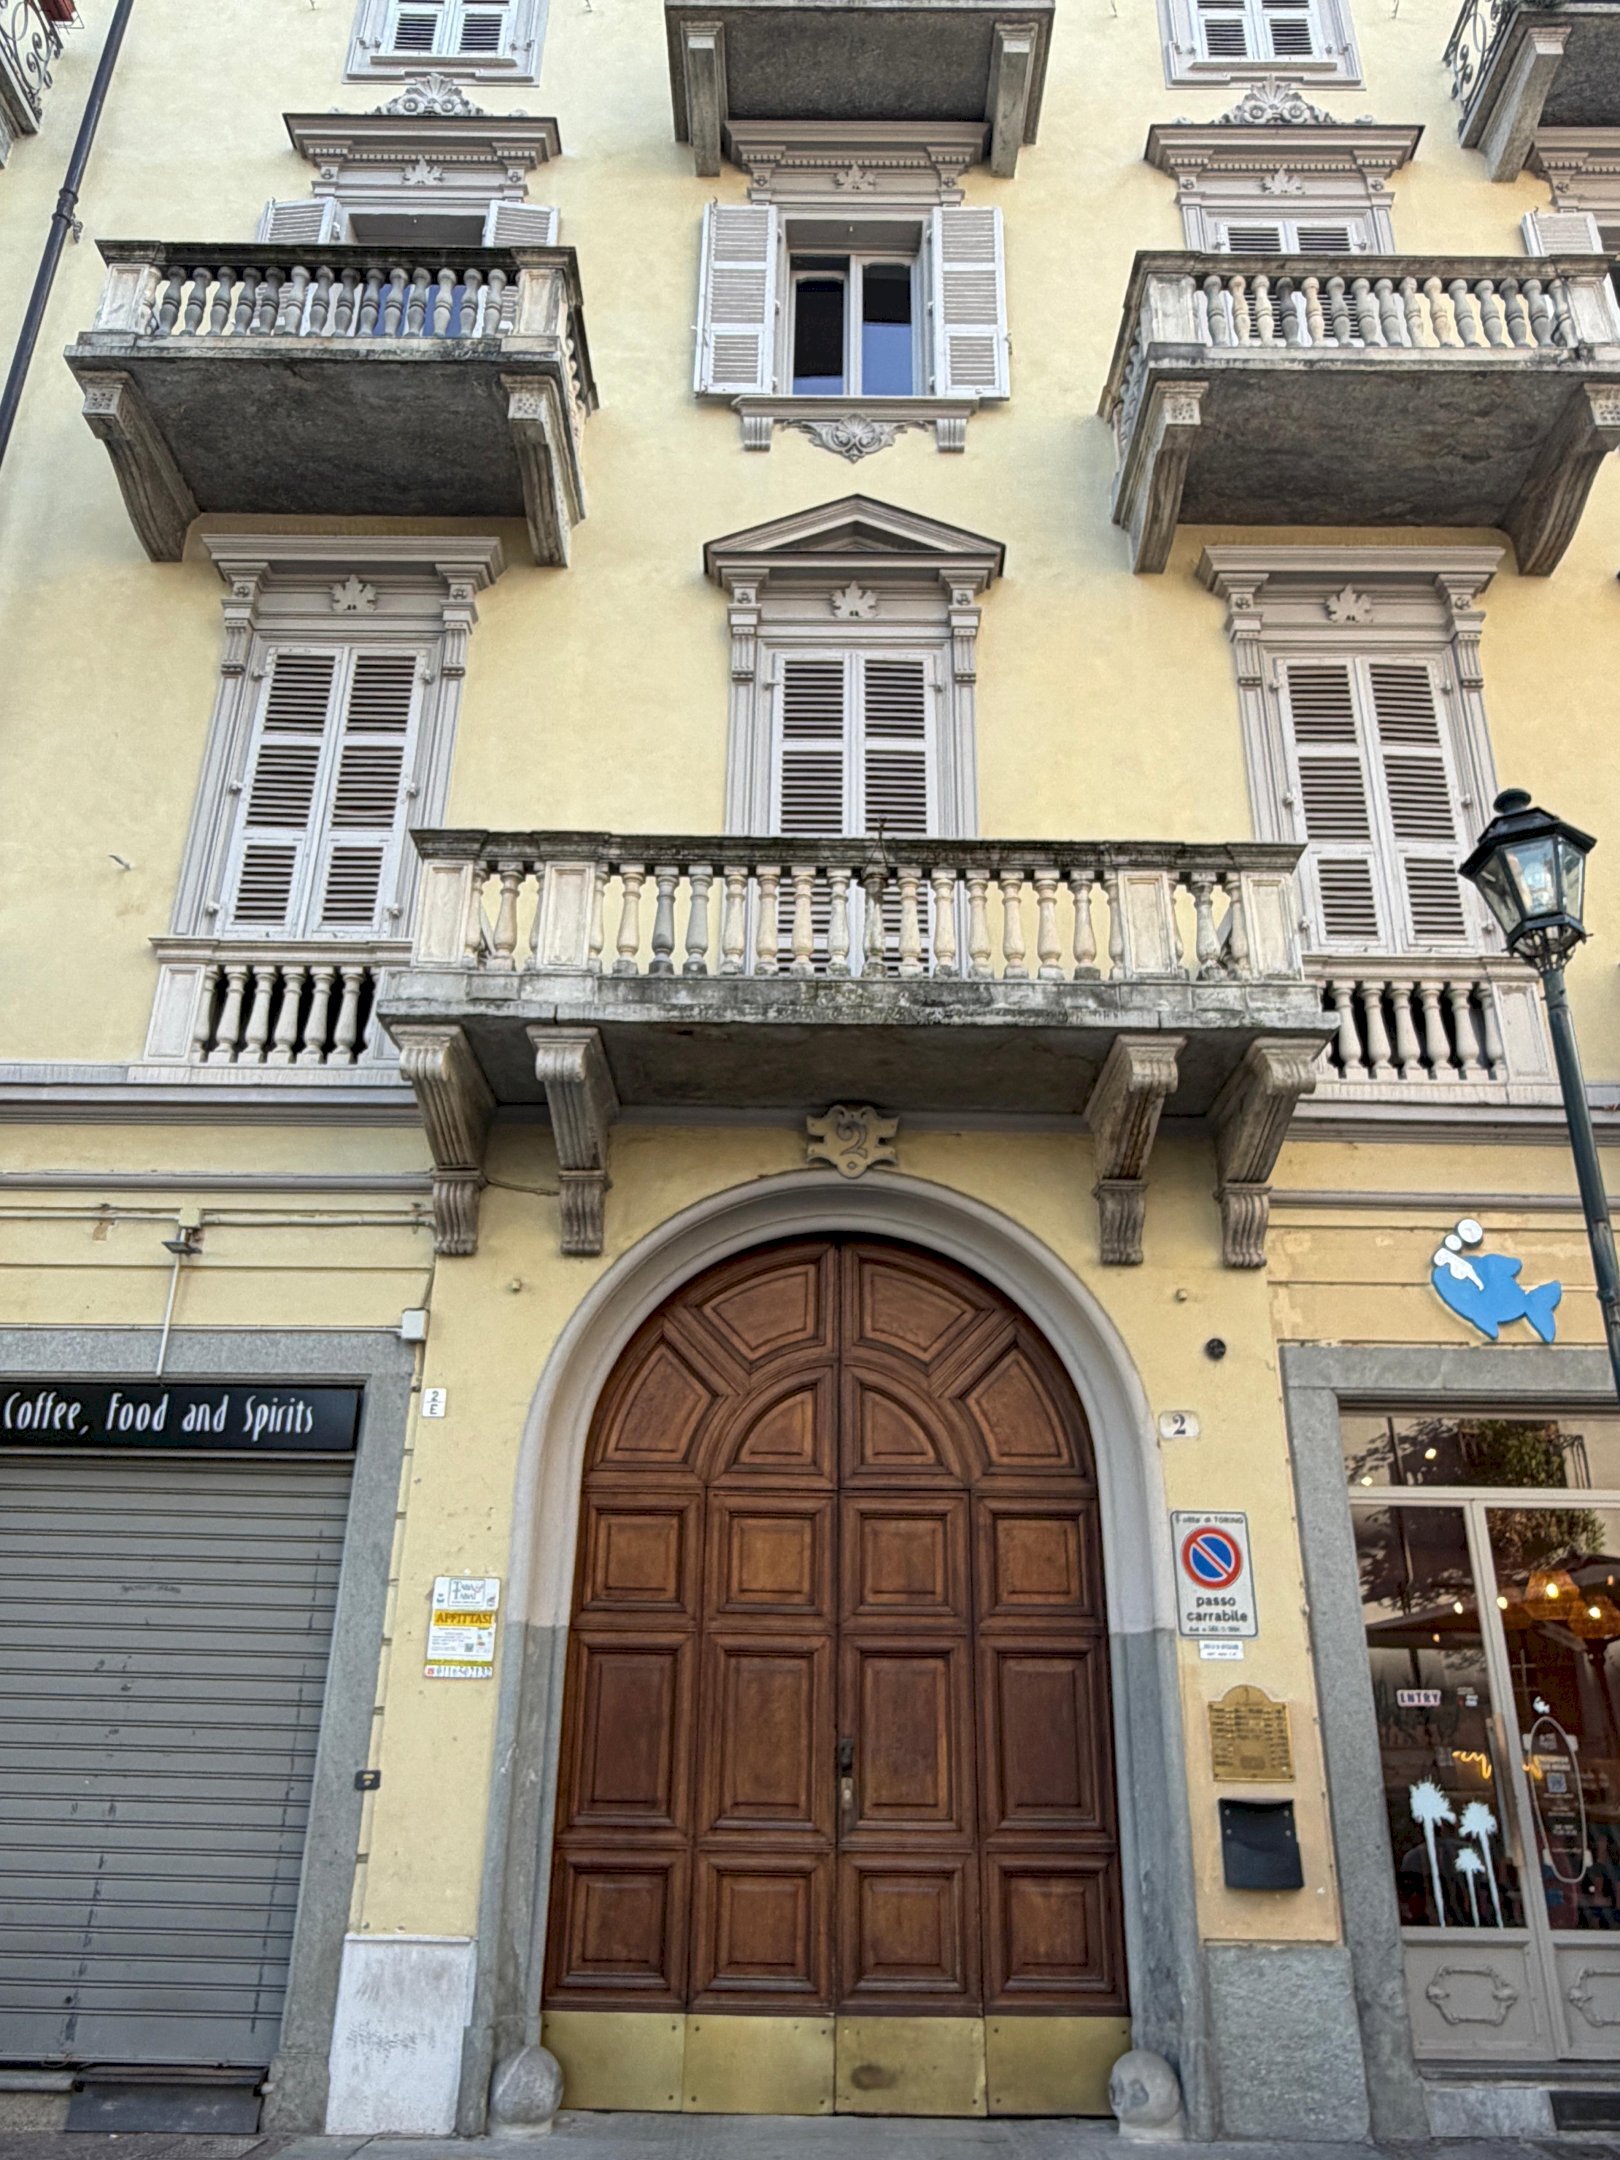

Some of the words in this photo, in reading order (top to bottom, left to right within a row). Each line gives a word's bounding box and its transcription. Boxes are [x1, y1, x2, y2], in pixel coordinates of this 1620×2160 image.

[837, 1121, 868, 1159] 2
[431, 1390, 440, 1402] 2
[430, 1403, 438, 1415] E
[4, 1391, 89, 1435] Coffee,
[105, 1392, 169, 1431] Food
[182, 1393, 229, 1432] and
[242, 1395, 313, 1442] Spirits
[1172, 1414, 1187, 1436] 2
[1196, 1596, 1236, 1608] passo
[1186, 1610, 1248, 1623] carrabile
